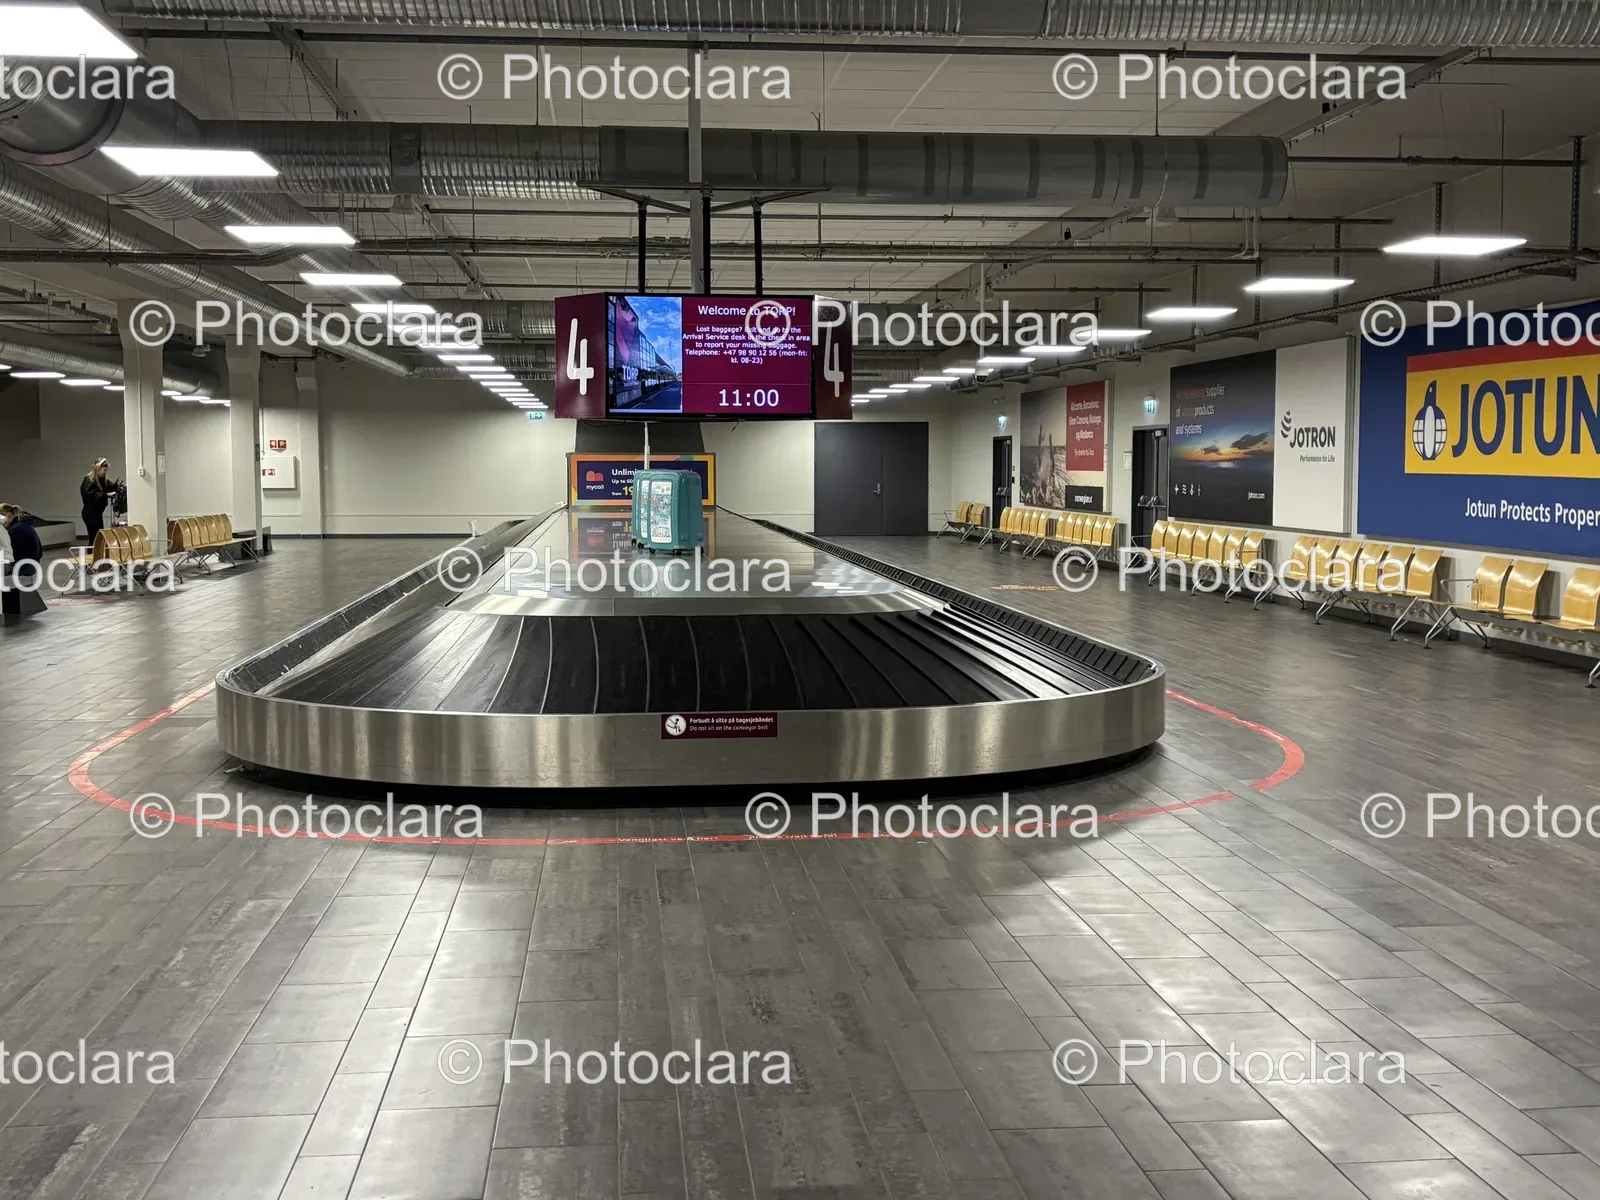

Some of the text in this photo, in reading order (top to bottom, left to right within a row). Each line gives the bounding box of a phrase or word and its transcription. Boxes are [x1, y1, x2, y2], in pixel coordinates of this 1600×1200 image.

[698, 306, 796, 316] Welcome to TORP!
[712, 326, 742, 334] baggage?
[567, 318, 594, 395] 4
[824, 322, 844, 398] 4
[719, 389, 779, 406] 11:00
[1452, 374, 1600, 458] JOTUN
[1184, 424, 1202, 437] systems
[1290, 426, 1335, 448] JOTRON
[1465, 498, 1496, 518] Jotun
[1501, 500, 1550, 522] Protects
